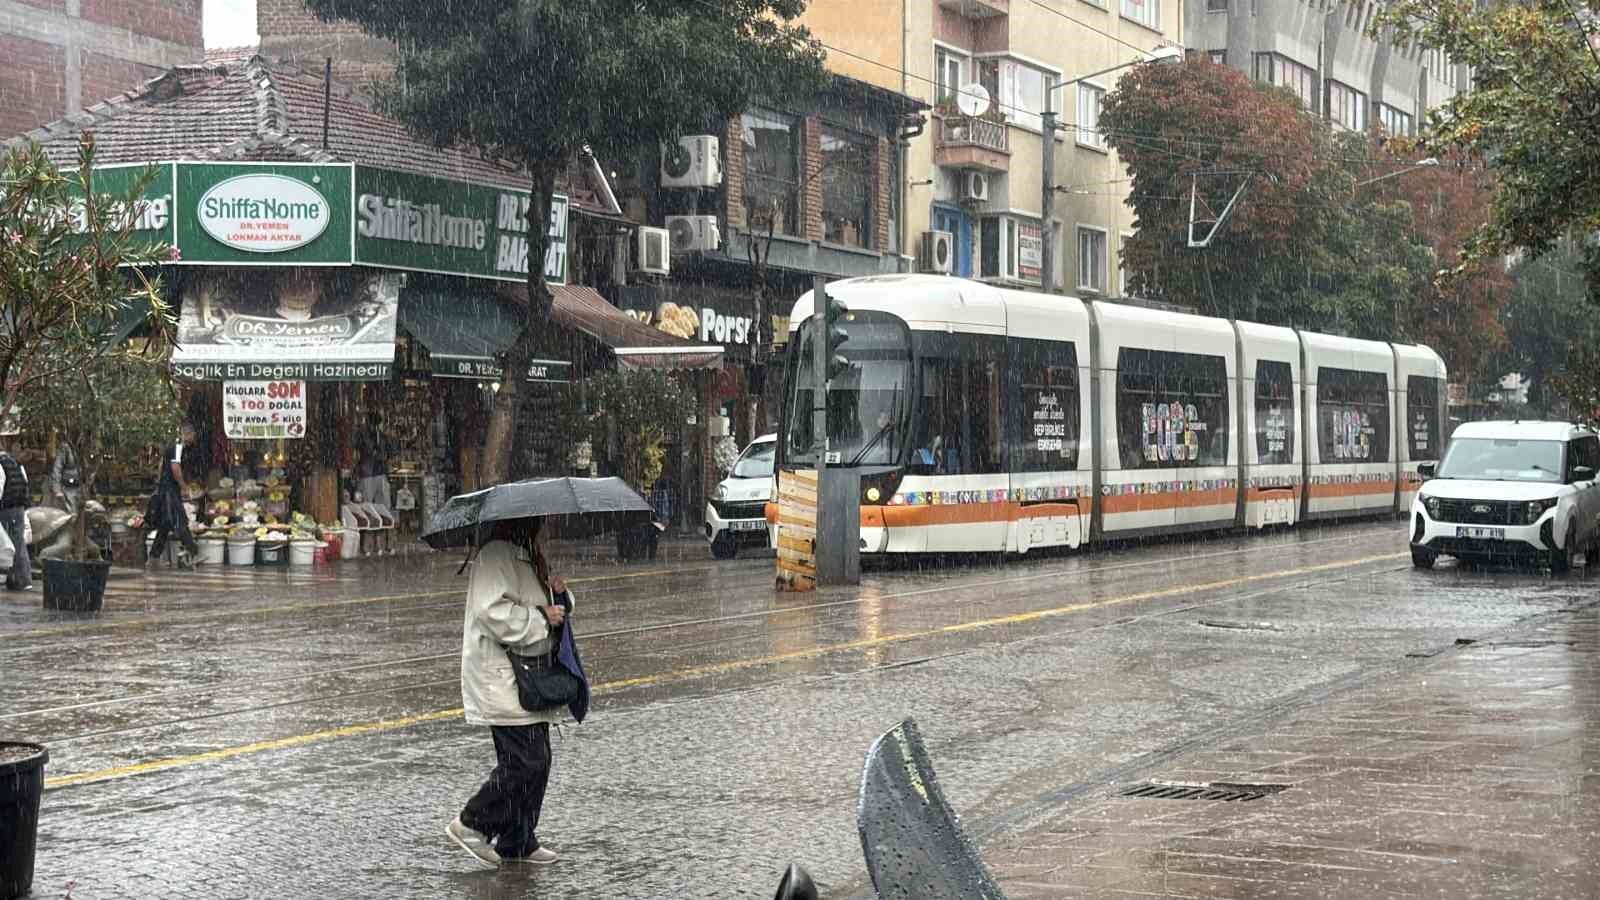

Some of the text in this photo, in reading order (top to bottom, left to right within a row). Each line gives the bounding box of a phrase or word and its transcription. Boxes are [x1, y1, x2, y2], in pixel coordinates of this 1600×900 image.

[497, 192, 567, 238] DR.YEN
[227, 233, 303, 241] LOKMAN AKTAR
[227, 364, 246, 377] En
[313, 363, 388, 377] Hazinedir
[267, 382, 301, 399] SON
[241, 401, 266, 410] 100
[271, 412, 280, 424] 5
